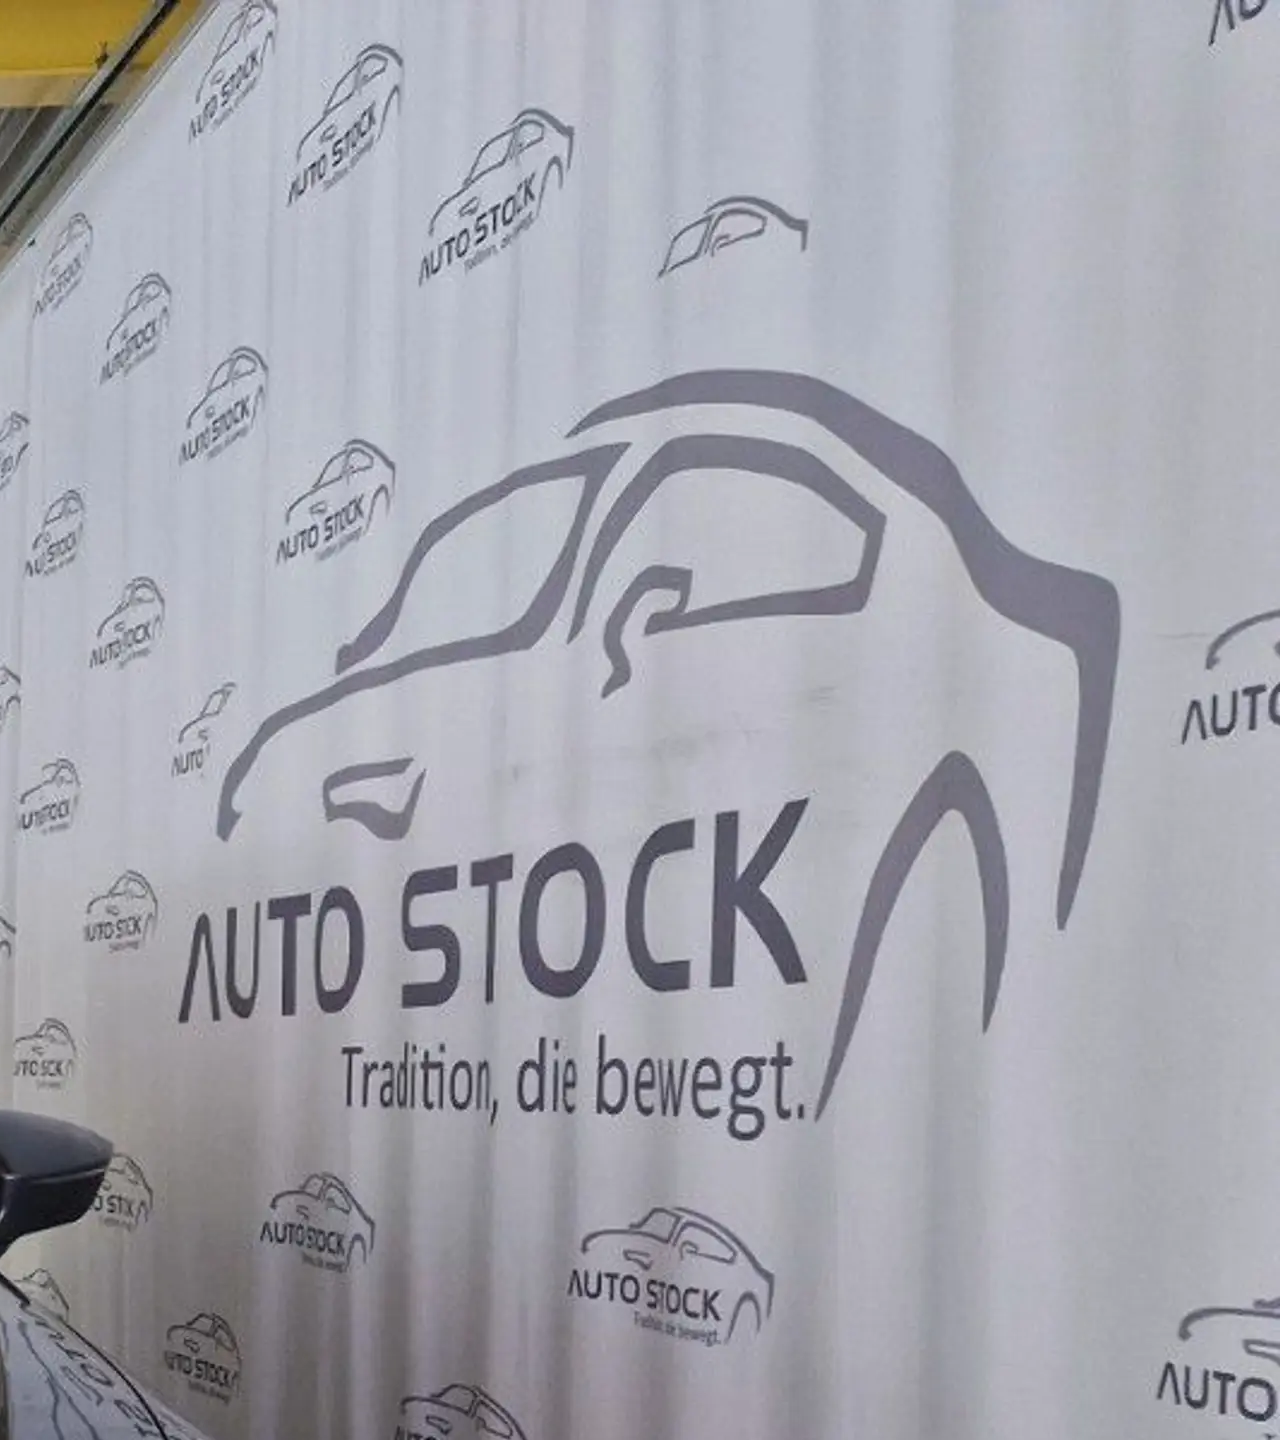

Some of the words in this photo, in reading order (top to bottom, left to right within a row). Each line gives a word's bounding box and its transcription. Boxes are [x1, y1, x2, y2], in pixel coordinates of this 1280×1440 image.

[418, 228, 471, 287] AUTO
[276, 524, 319, 566] AUTO
[178, 885, 365, 1023] AUTO
[401, 798, 810, 1009] STOCK
[342, 1042, 498, 1126] Tradition,
[517, 1037, 578, 1113] die
[596, 1034, 805, 1141] bewegt.
[260, 1221, 305, 1246] AUTO
[567, 1269, 640, 1304] AUTO
[646, 1279, 722, 1321] STOCK
[1156, 1360, 1278, 1421] AUTO
